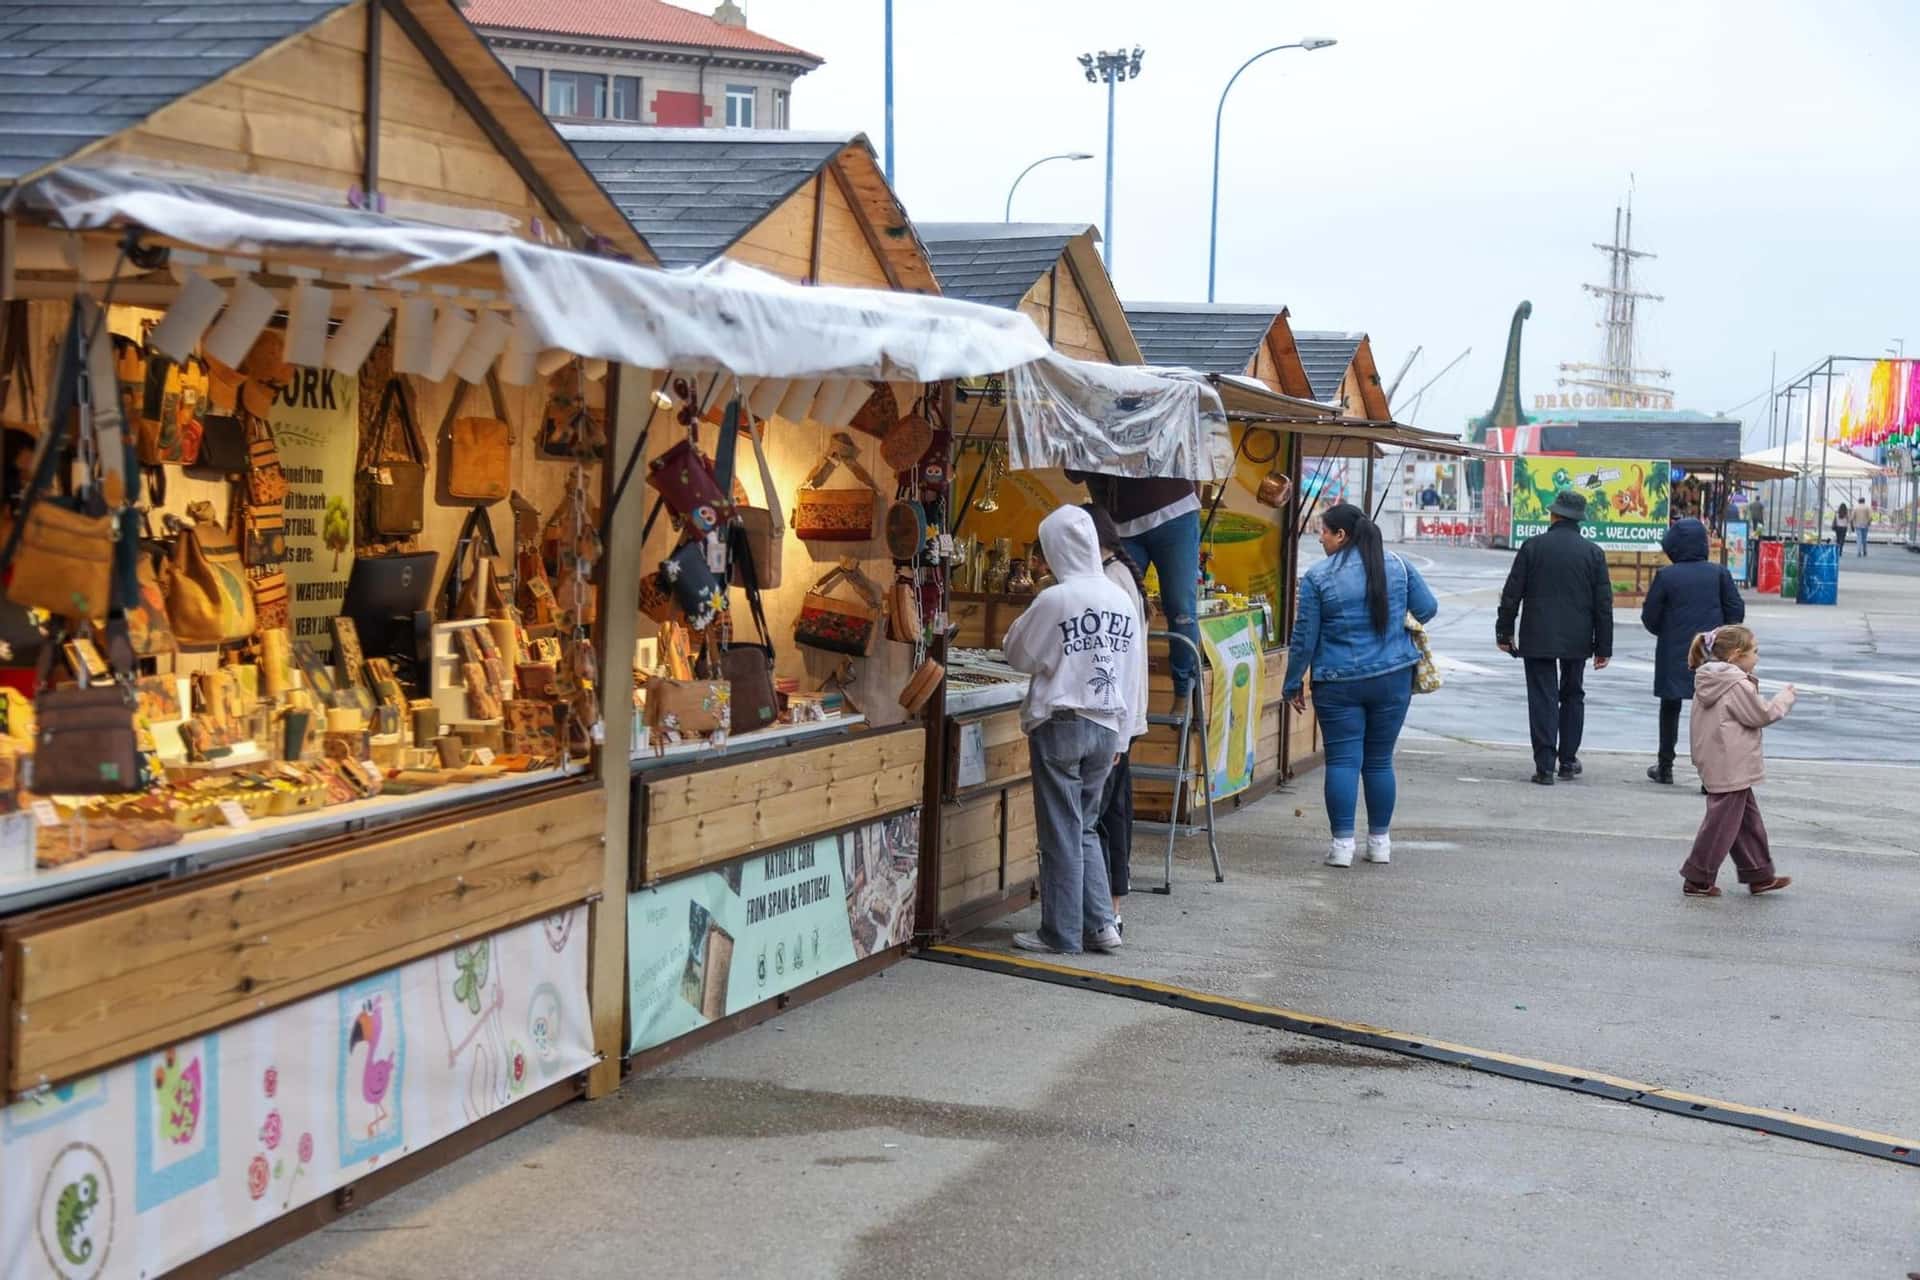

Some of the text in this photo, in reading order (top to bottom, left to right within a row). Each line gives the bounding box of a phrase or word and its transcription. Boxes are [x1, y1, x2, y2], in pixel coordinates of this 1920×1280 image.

[274, 366, 337, 410] ORK
[283, 518, 318, 536] RTUGAL.
[1606, 526, 1664, 540] WELCOME
[764, 847, 796, 881] NATURAL
[746, 874, 831, 927] FROM SPAIN & PORTUGAL
